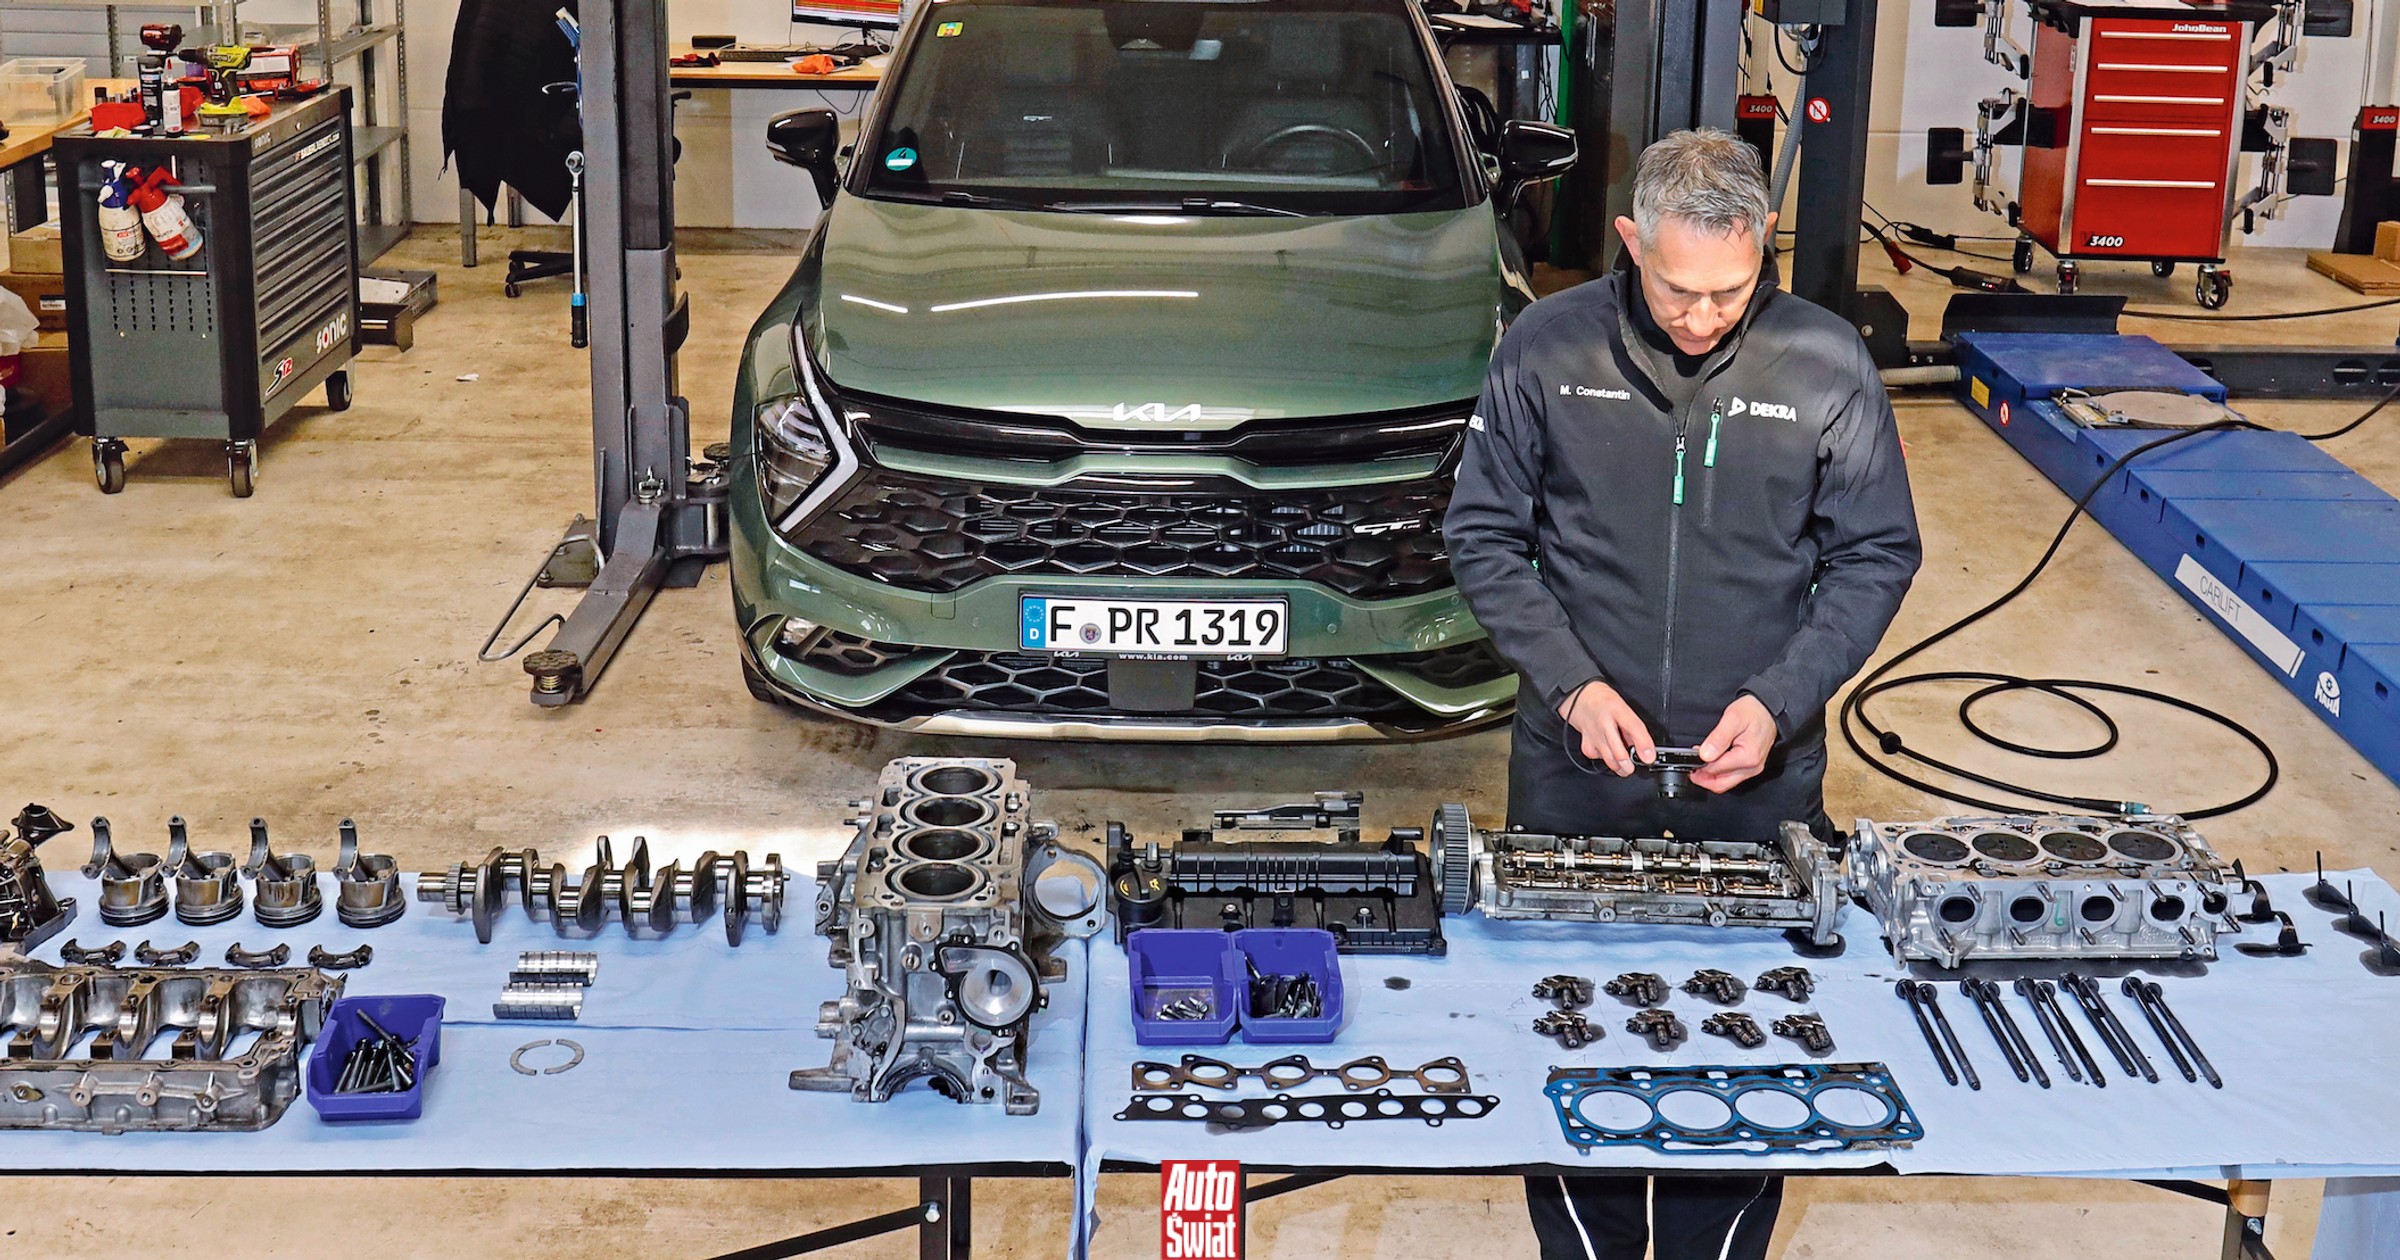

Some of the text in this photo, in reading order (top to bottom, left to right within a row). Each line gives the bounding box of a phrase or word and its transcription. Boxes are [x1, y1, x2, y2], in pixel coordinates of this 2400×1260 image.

[1559, 384, 1631, 400] M. Constantin
[1113, 402, 1202, 422] KIA
[1749, 401, 1798, 422] DEKRA
[2200, 575, 2242, 622] CARLIFT
[1029, 628, 1040, 640] D
[1050, 605, 1280, 646] F PR 1319
[1118, 652, 1188, 661] www.kia.com
[2314, 680, 2341, 718] MAHA
